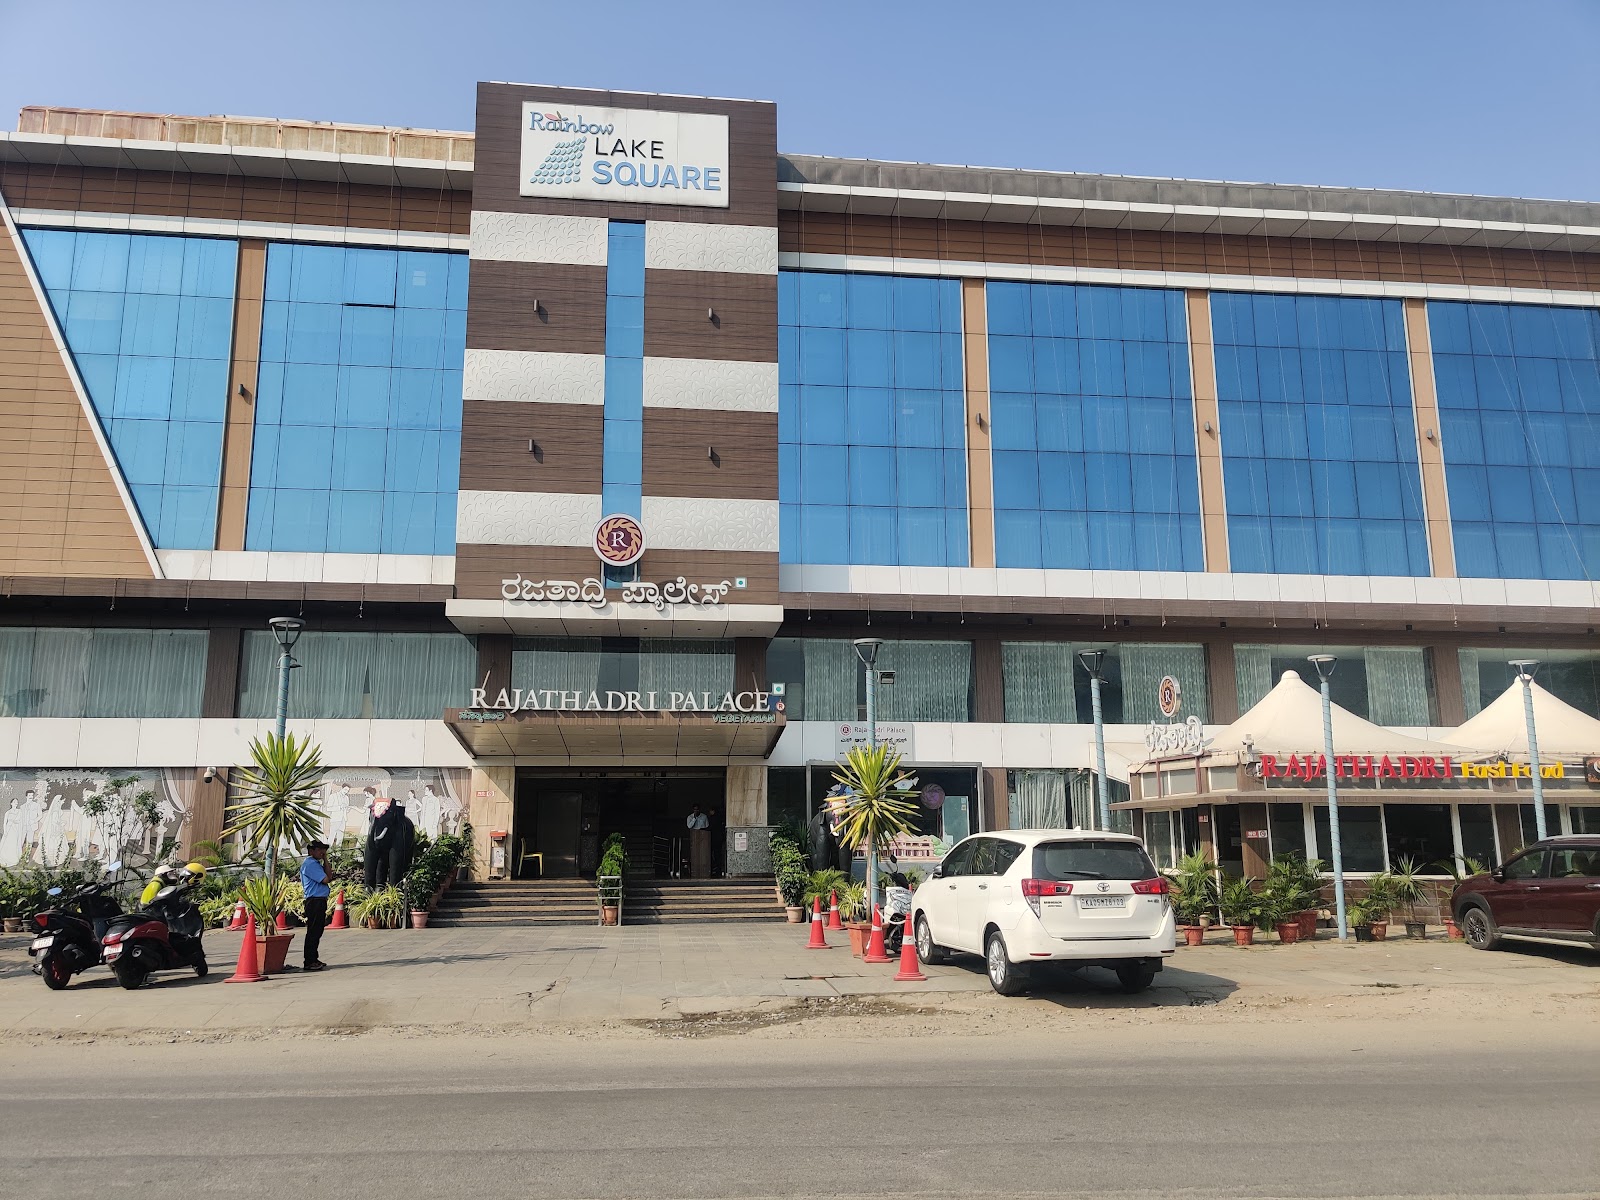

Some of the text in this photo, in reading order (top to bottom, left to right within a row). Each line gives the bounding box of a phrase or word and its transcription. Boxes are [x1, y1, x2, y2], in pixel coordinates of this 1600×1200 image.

[529, 111, 614, 135] Rainbow
[595, 137, 664, 159] LAKE
[592, 160, 721, 191] SQUARE
[611, 530, 628, 549] R
[501, 573, 732, 611] ರಜತಾದ್ರಿ ಪ್ಯಾಲೇಸ್
[468, 688, 770, 713] RAJATHADRI PALACE
[712, 713, 776, 723] VEGETARIAN
[887, 726, 906, 734] Palace
[1461, 761, 1506, 778] Fast
